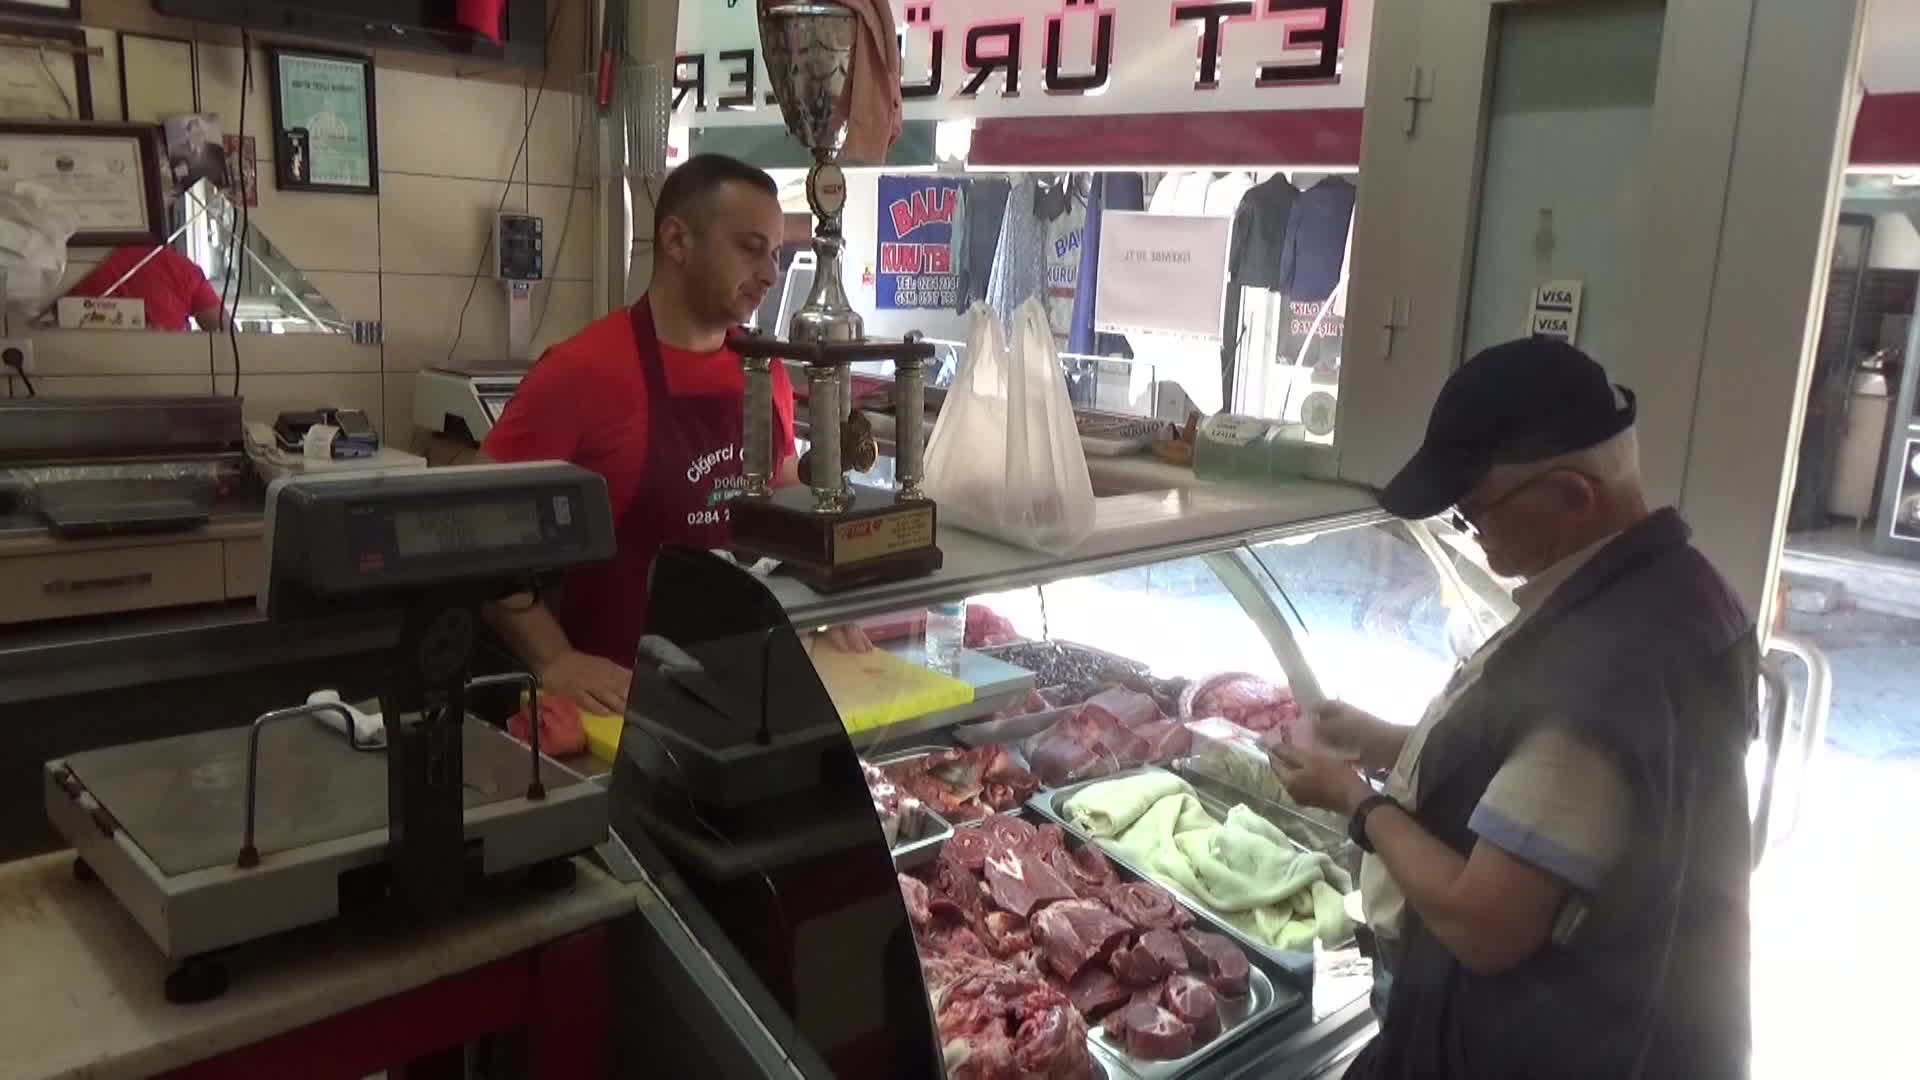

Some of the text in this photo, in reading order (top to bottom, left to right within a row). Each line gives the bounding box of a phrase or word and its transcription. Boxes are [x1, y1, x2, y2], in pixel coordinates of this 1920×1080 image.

[881, 242, 921, 274] KURU
[1542, 290, 1572, 304] VISA
[1539, 319, 1568, 331] VISA
[687, 510, 720, 525] 0284
